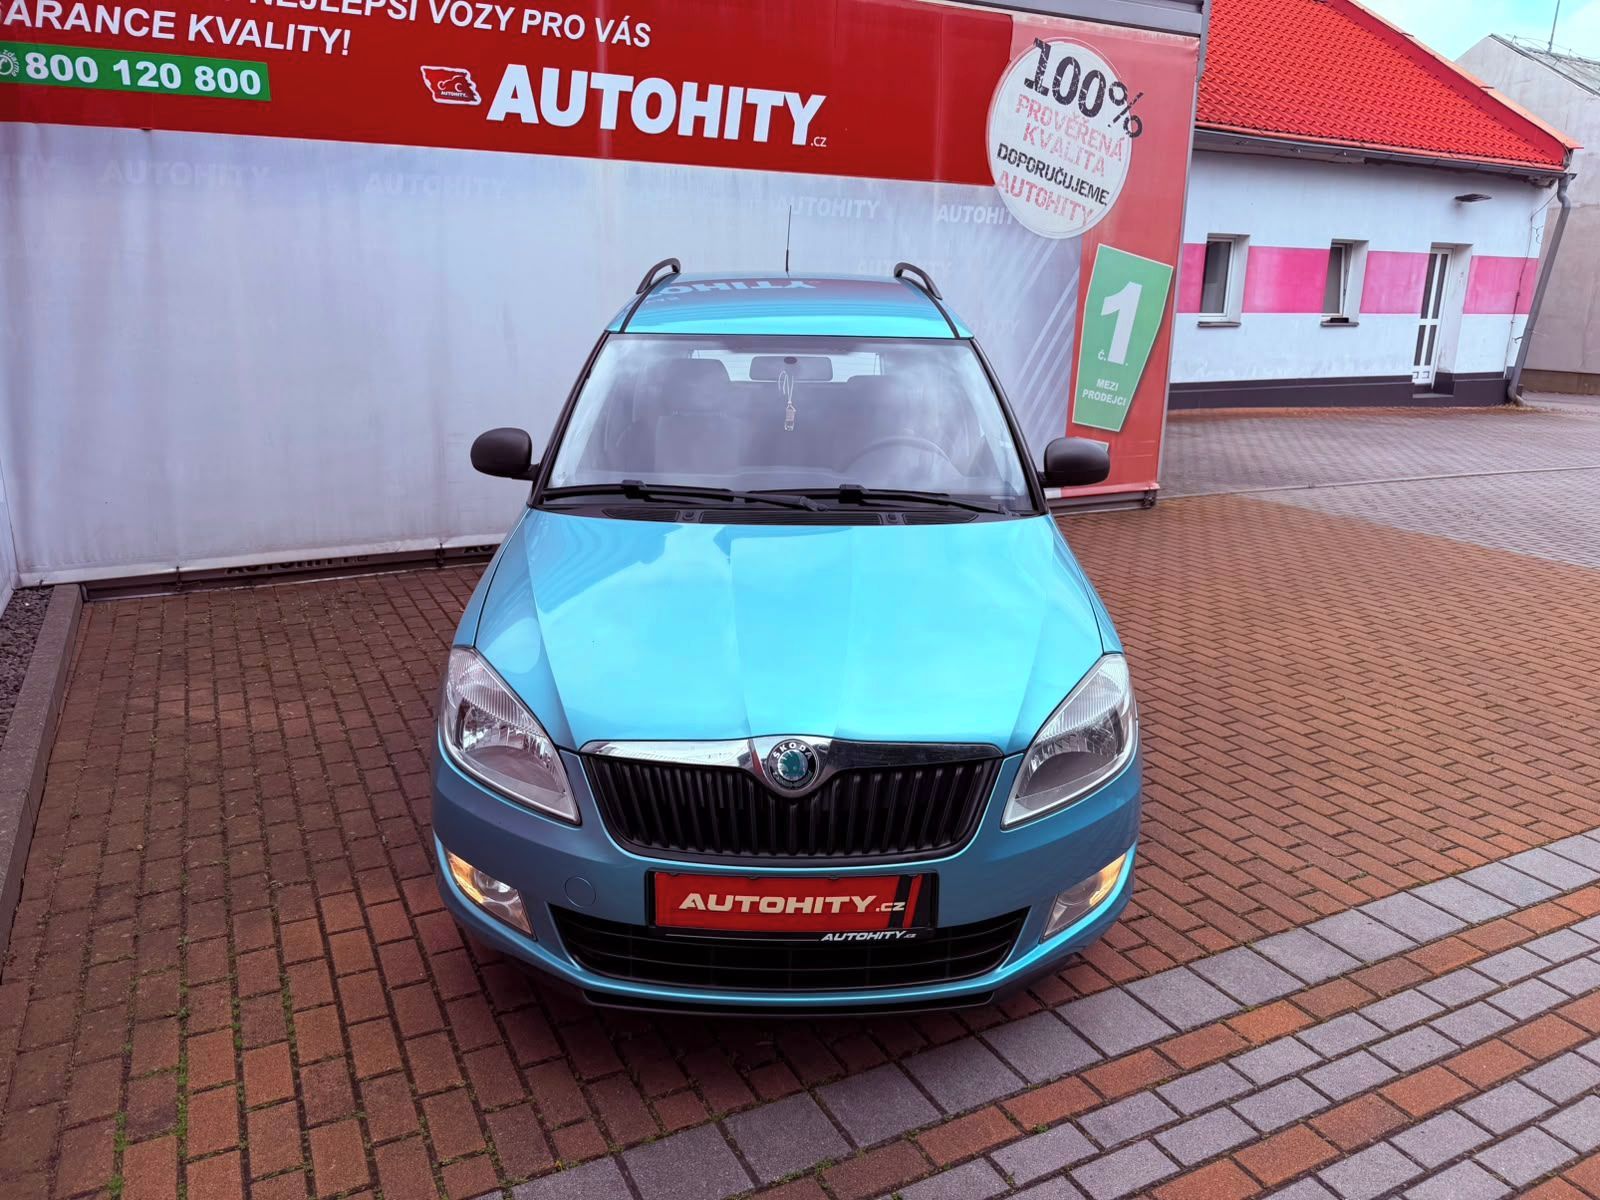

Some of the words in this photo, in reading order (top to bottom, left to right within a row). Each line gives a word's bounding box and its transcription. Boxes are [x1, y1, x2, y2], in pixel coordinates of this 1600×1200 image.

[0, 0, 176, 39] ARANCE
[188, 14, 350, 56] KVALITY!
[428, 0, 515, 31] VOZY
[521, 8, 586, 39] PRO
[595, 15, 651, 47] VÁS
[25, 52, 98, 83] 800
[113, 59, 182, 89] 120
[195, 66, 261, 95] 800
[1024, 37, 1144, 138] 100%
[1015, 93, 1126, 162] PROVĚŘENÁ
[1022, 122, 1105, 177] KVALITA
[997, 143, 1110, 206] DOPORUČUJEME
[998, 170, 1095, 226] AUTOHITY
[934, 205, 1013, 225] AUTOHIT
[1082, 388, 1127, 406] PRODEJCI
[1096, 378, 1119, 391] MEZI
